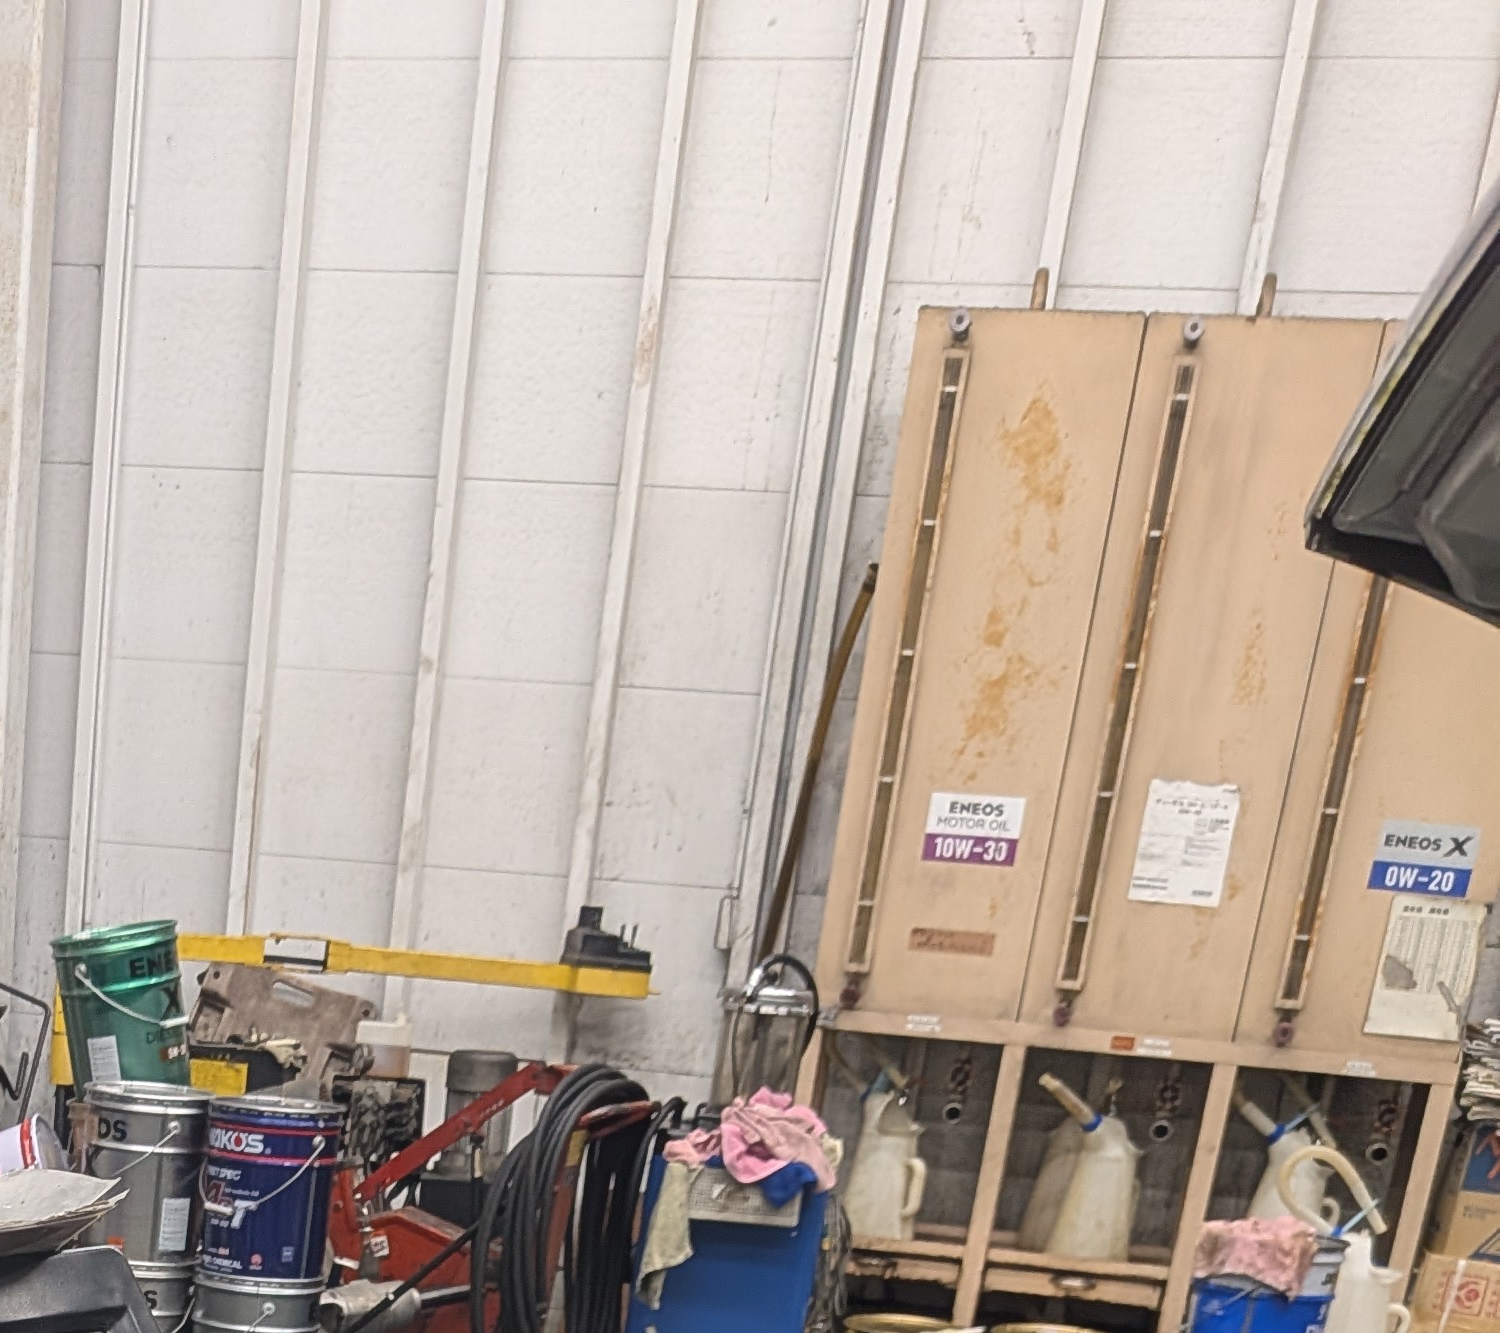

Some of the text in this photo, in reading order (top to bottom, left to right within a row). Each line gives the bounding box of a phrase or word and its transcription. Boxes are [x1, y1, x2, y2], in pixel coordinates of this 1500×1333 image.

[949, 802, 1004, 817] ENEOS
[936, 817, 1011, 831] MOTOR OIL
[934, 837, 1009, 862] 10W-30
[1384, 834, 1474, 858] ENEOS X
[1384, 866, 1455, 893] 0W-20
